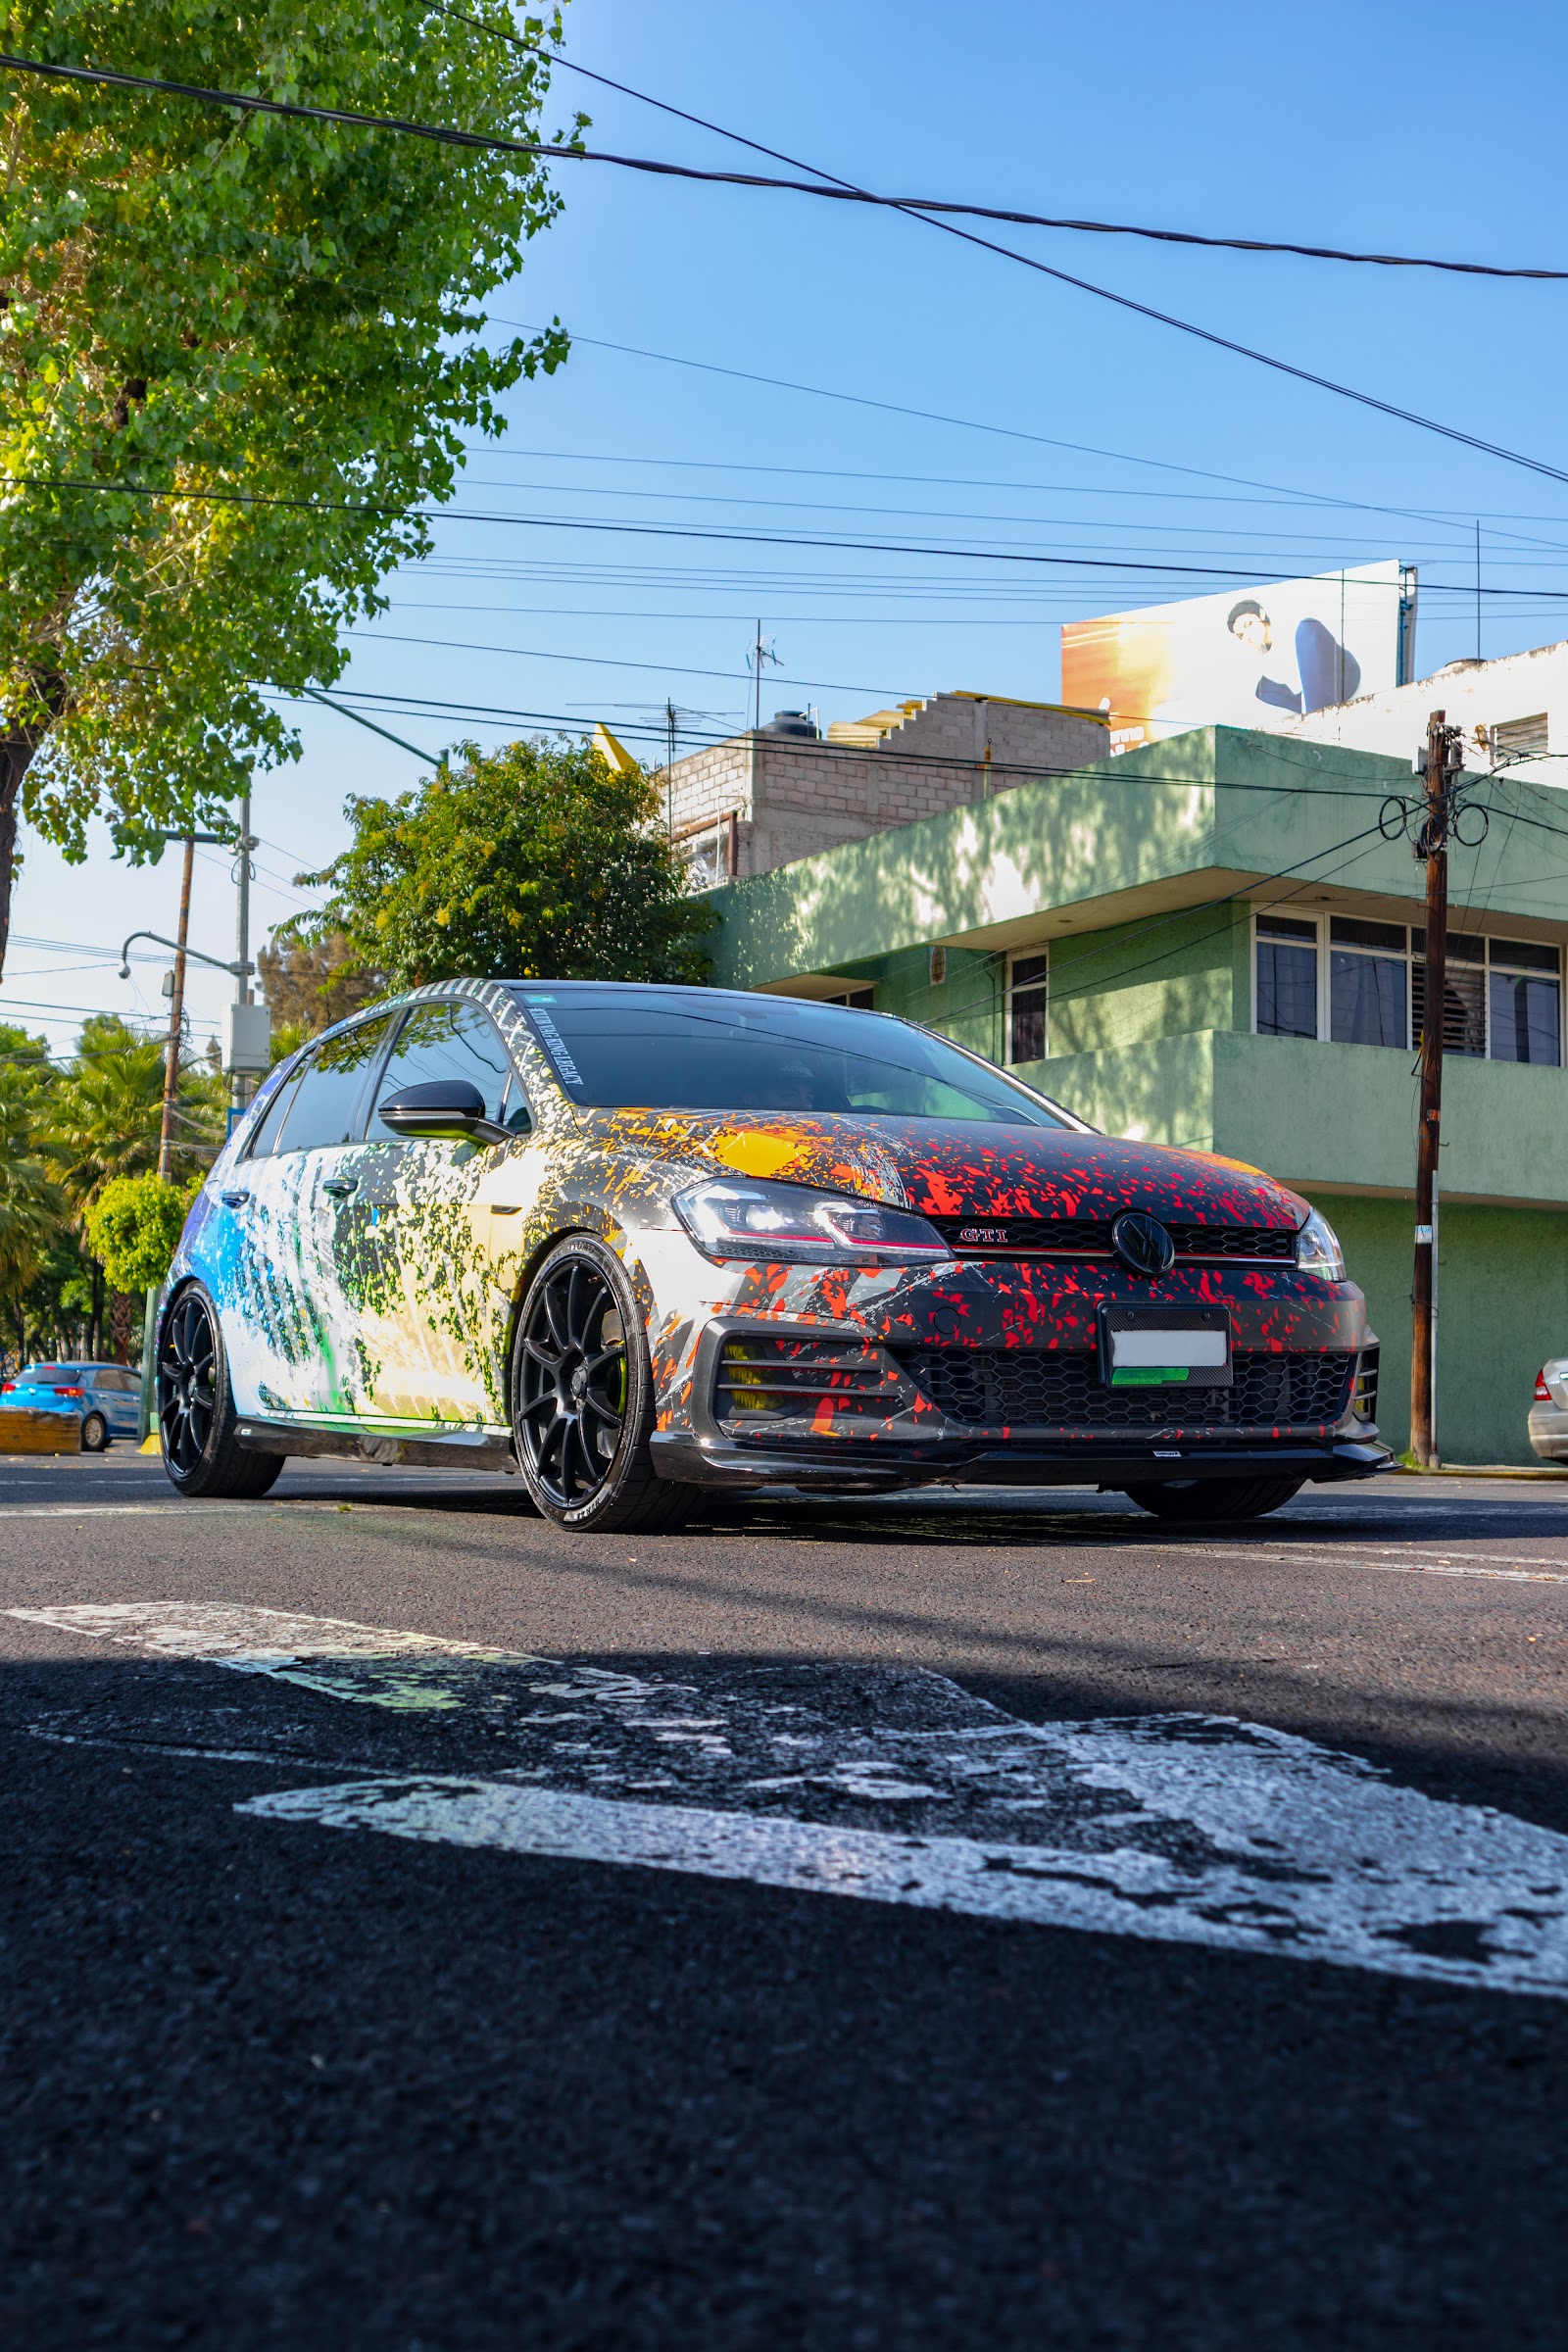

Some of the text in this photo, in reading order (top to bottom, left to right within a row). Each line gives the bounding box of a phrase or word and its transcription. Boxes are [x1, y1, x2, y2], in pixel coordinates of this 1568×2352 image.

[538, 1024, 560, 1038] VAG
[545, 1038, 568, 1055] KING
[554, 1055, 583, 1085] LEGACY
[960, 1228, 1008, 1243] GTI
